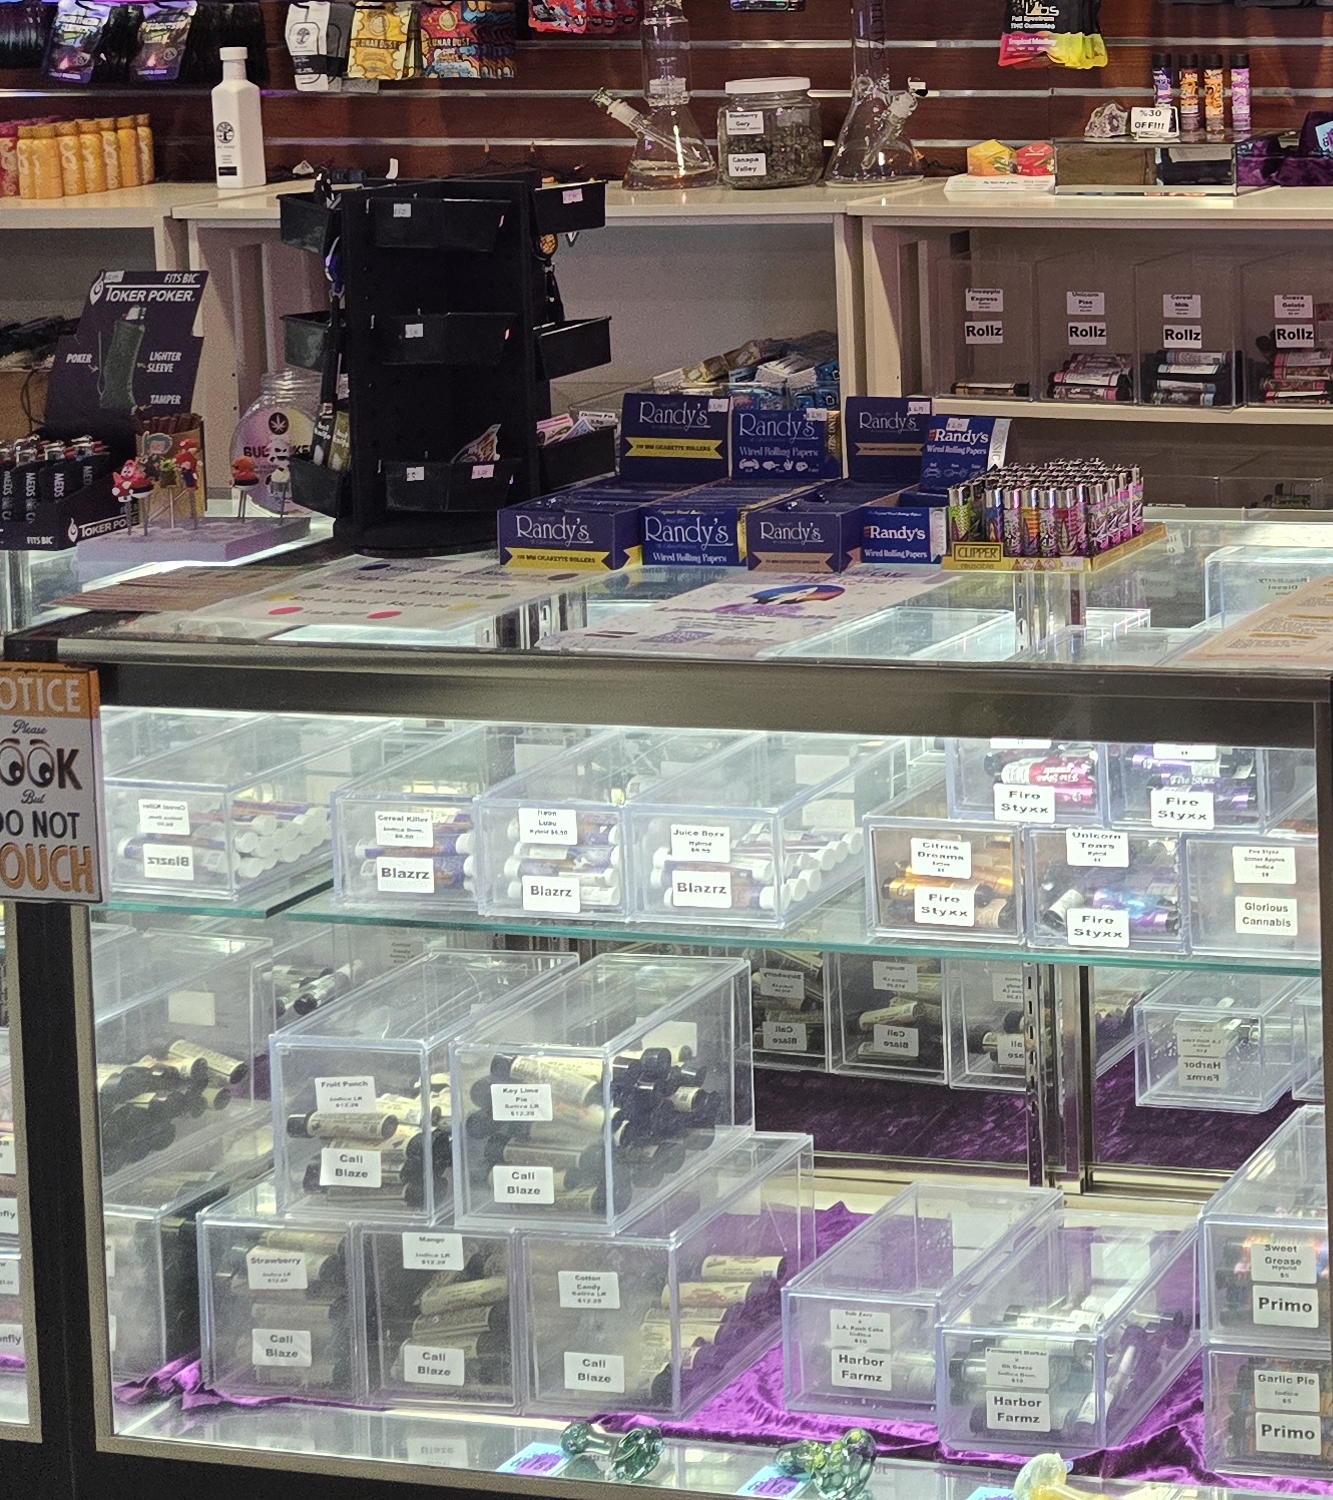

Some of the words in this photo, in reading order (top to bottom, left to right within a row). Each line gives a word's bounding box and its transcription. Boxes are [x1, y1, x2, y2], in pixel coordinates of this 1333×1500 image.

[164, 273, 180, 283] FITS
[182, 273, 195, 283] BIC
[967, 326, 1002, 337] Rollz
[1069, 326, 1106, 337] Rollz
[1165, 329, 1201, 341] Rollz
[1277, 328, 1313, 339] Rollz
[66, 354, 92, 363] POKER
[150, 352, 181, 361] LIGHTER
[147, 364, 173, 372] SLEEVE
[151, 395, 180, 404] TAMPER
[638, 401, 711, 430] Randy's
[859, 411, 918, 433] Randy's
[738, 414, 819, 443] Randy's
[935, 429, 989, 444] Randy's
[516, 515, 590, 546] Randy's
[958, 548, 998, 559] CLIPPER
[0, 678, 80, 712] OTICE
[12, 720, 47, 734] Please
[1009, 791, 1040, 800] Fire
[1001, 802, 1049, 815] Styxx
[1158, 809, 1207, 821] Styxx
[0, 842, 94, 893] OUCH
[381, 868, 430, 880] Blazrz
[531, 886, 572, 897] Blazrz
[677, 882, 727, 894] Blazrz
[921, 906, 967, 918] Styxx
[1244, 902, 1288, 913] Glorious
[1242, 916, 1291, 928] Cannabis
[340, 1154, 363, 1163] Cali
[335, 1168, 368, 1179] Blaze
[512, 1171, 534, 1180] Cali
[507, 1186, 540, 1195] Blaze
[251, 1256, 301, 1266] Strawberry
[1265, 1256, 1302, 1266] Grease
[1259, 1297, 1313, 1313] Primo
[266, 1349, 298, 1359] Blaze
[838, 1355, 884, 1367] Harbor
[842, 1370, 883, 1383] Farmz
[1258, 1374, 1289, 1384] Garlic
[1294, 1376, 1315, 1385] Pie
[993, 1397, 1042, 1407] Harbor
[997, 1412, 1040, 1424] Farmz
[1261, 1424, 1316, 1440] Primo
